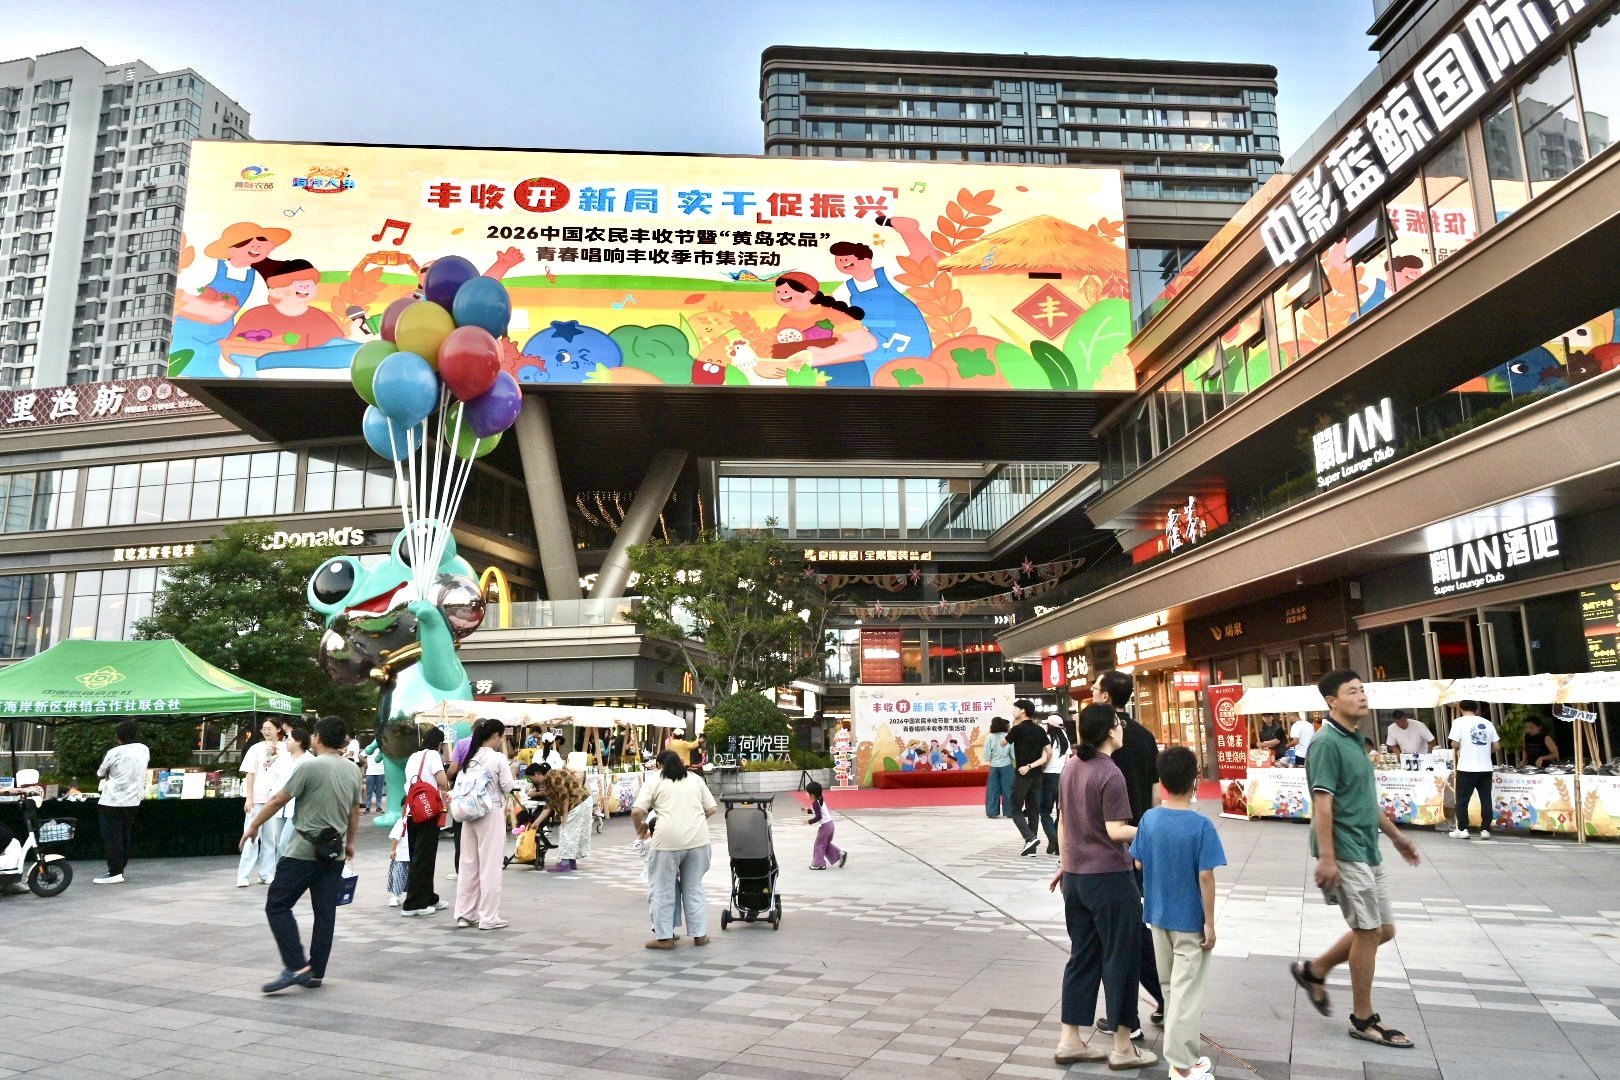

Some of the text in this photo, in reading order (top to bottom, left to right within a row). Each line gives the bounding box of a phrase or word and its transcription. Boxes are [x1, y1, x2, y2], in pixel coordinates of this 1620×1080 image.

[1260, 0, 1586, 268] 中影蓝鲸国际
[428, 182, 888, 218] 丰收开新局 实干促振兴
[486, 226, 831, 248] 2026中国农民丰收节暨“黄岛农品”
[536, 246, 781, 267] 青春唱响丰收季市集活动
[1032, 296, 1068, 328] 丰
[1317, 445, 1395, 488] Super Lounge Club
[1433, 571, 1505, 595] Super Lounge Club
[0, 699, 181, 713] 海岸新区供销合作社联合社
[873, 701, 993, 712] 丰收开新局 实干促振兴
[739, 735, 790, 753] 荷悦里
